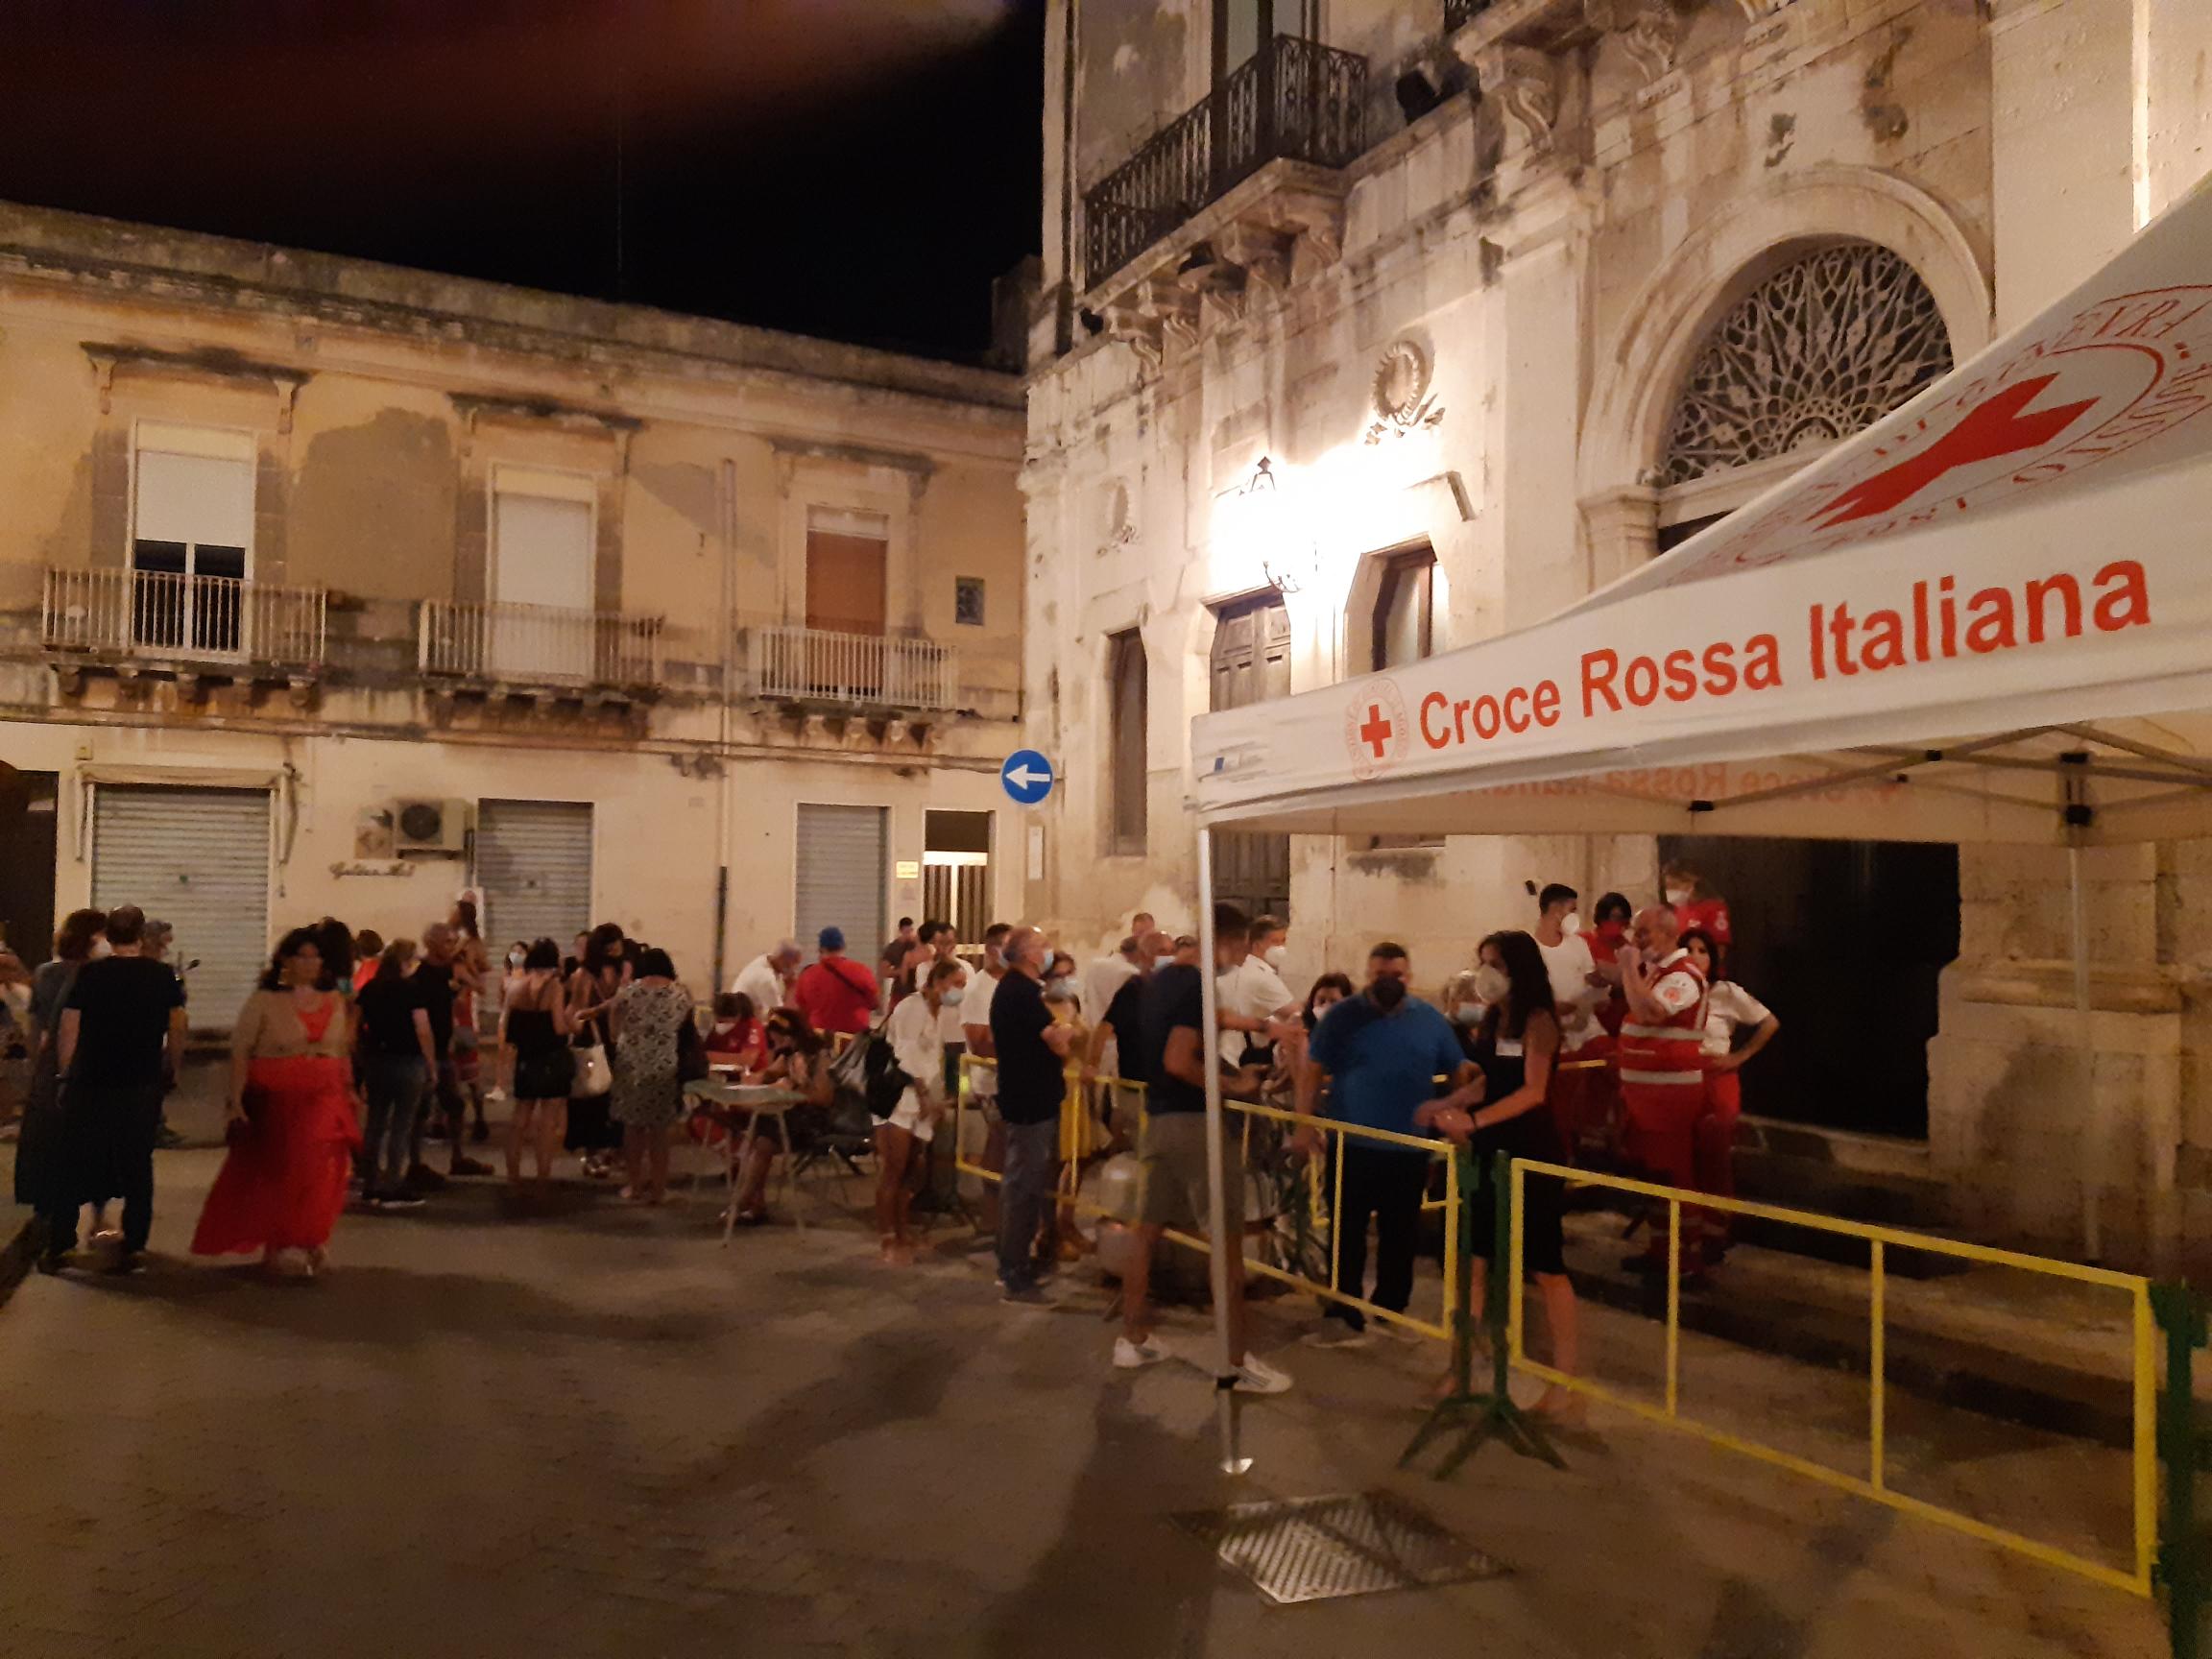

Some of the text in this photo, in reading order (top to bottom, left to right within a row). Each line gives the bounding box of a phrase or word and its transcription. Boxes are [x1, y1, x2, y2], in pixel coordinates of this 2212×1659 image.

[1420, 681, 1562, 749] Croce
[1580, 633, 1783, 718] Rossa
[1811, 560, 2152, 681] Italiana
